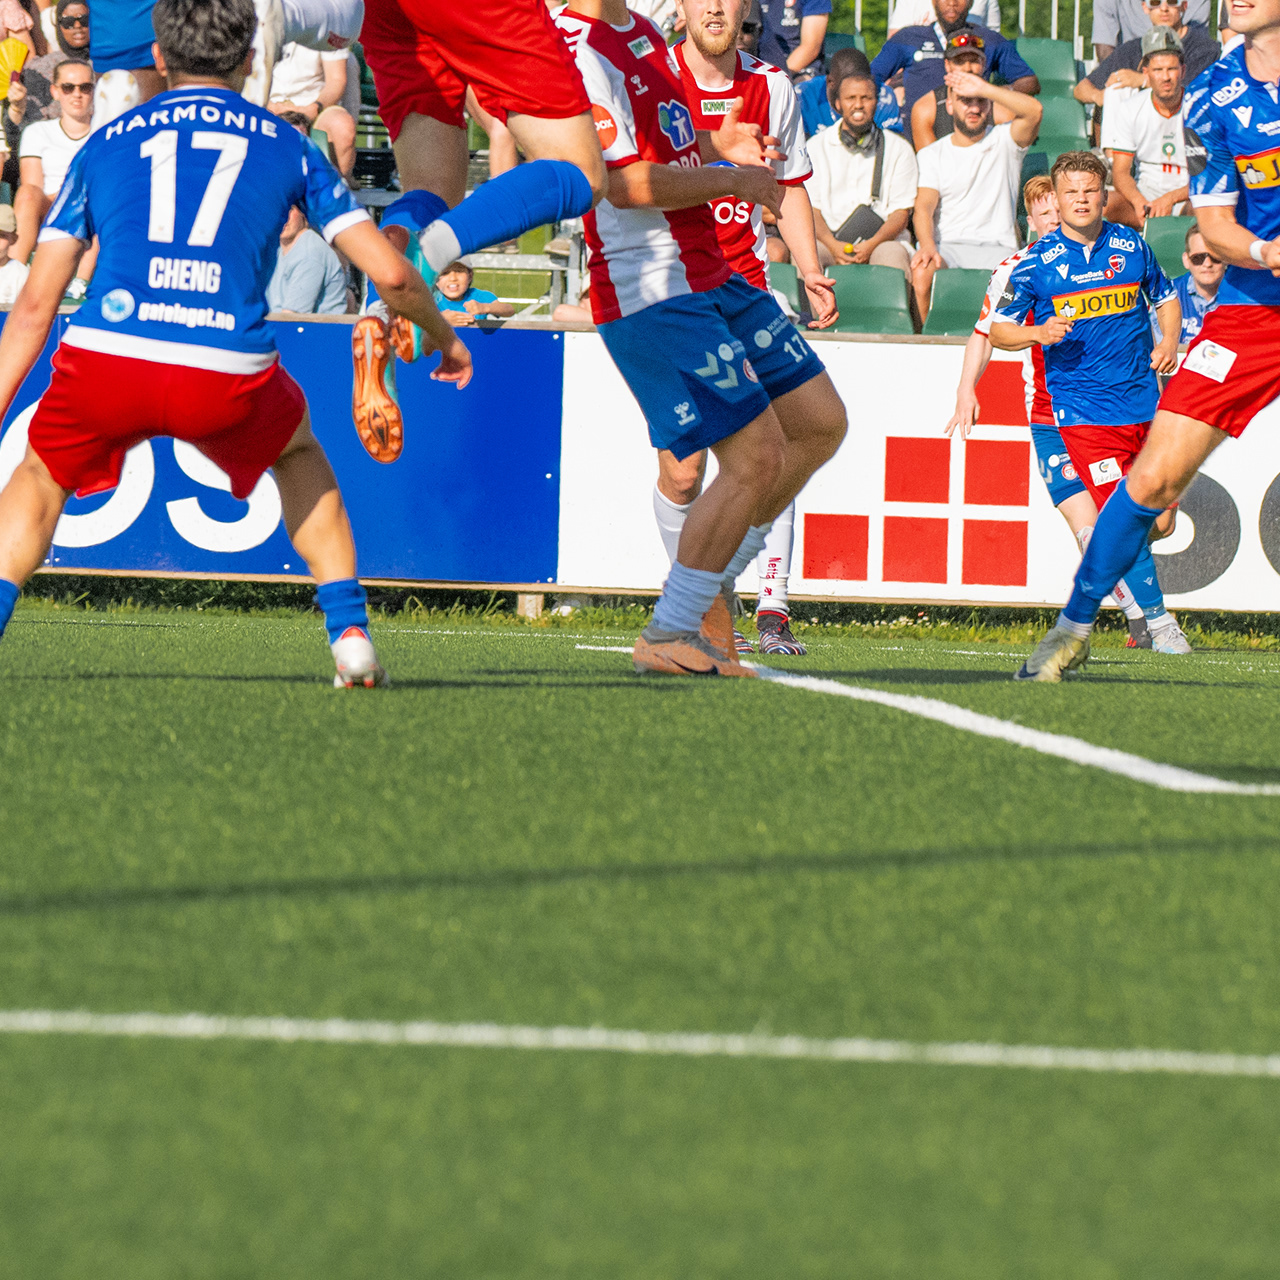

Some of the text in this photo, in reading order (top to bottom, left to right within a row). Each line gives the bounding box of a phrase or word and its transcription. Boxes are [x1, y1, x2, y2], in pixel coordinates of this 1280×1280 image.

[106, 104, 277, 140] HARMONIE
[140, 129, 249, 247] 17
[714, 201, 750, 225] OS
[148, 257, 221, 293] CHENG
[1080, 289, 1138, 315] JOTUN
[783, 333, 808, 363] 17
